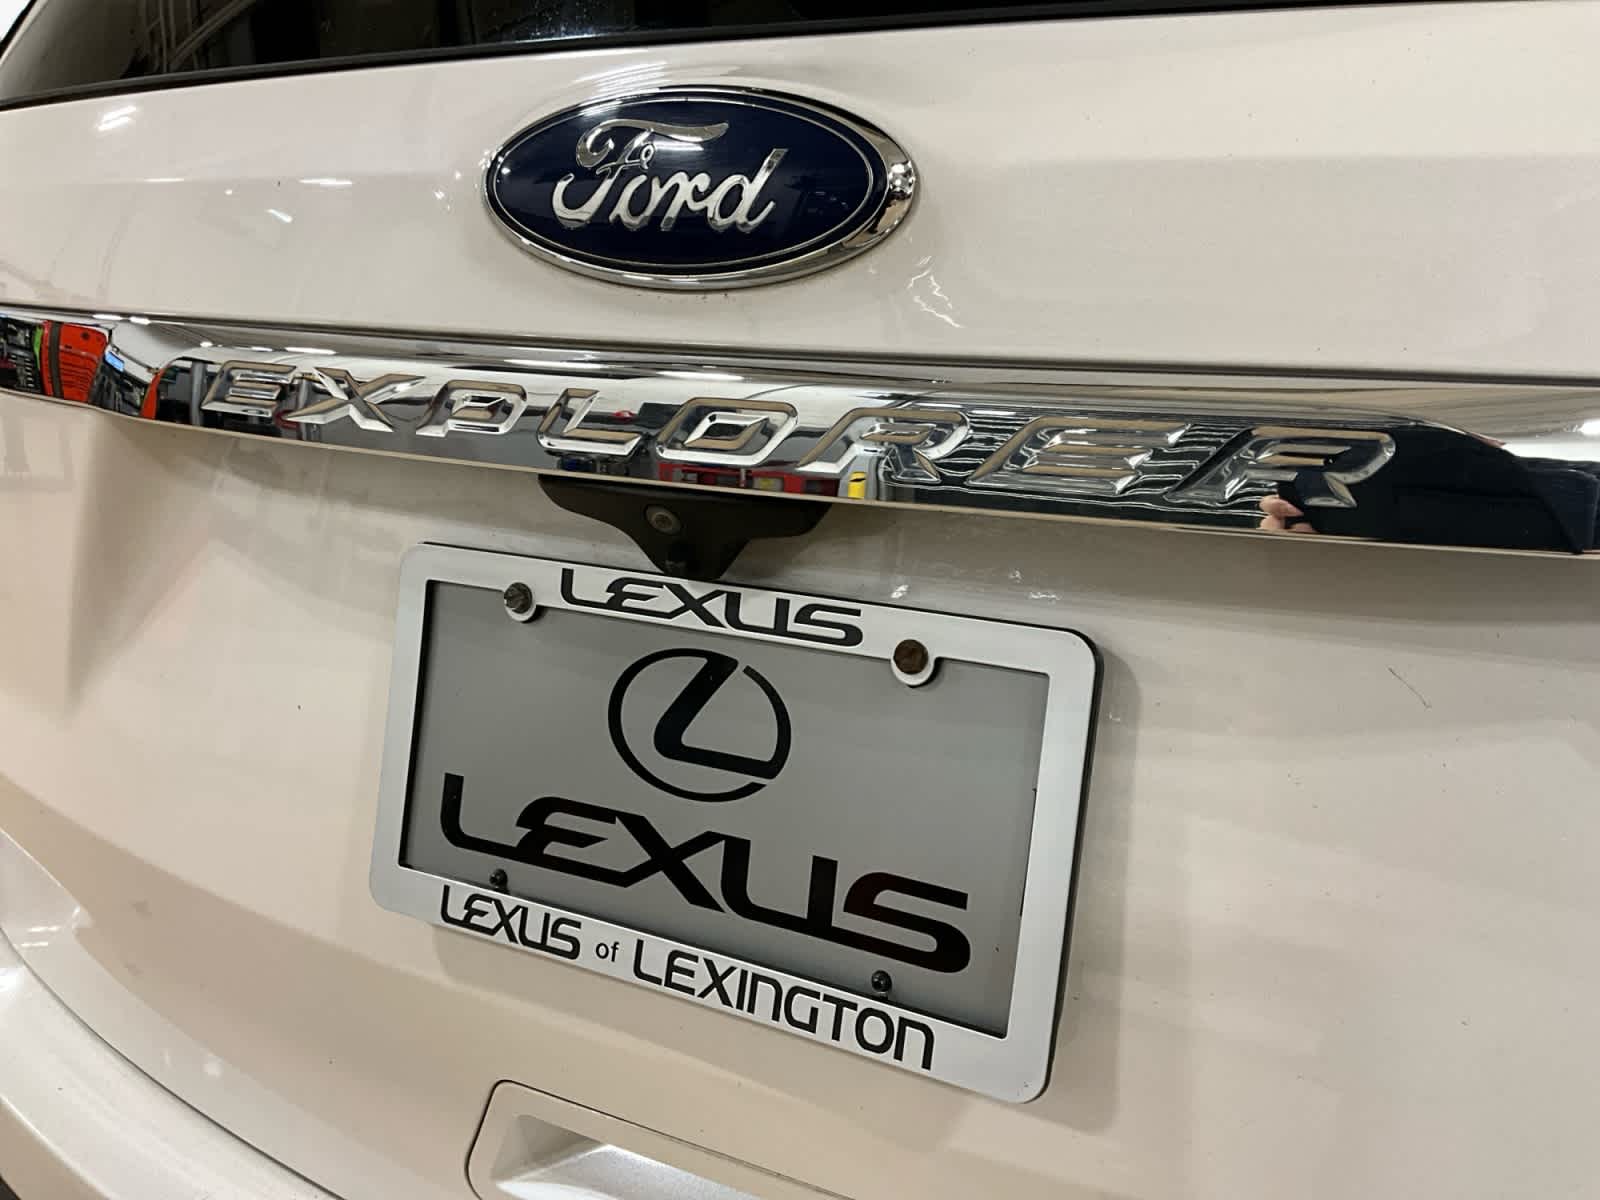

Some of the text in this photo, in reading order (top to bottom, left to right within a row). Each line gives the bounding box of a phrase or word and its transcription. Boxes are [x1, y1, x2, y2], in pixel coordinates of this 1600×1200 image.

[551, 118, 790, 232] Ford
[200, 359, 1397, 510] EXPLORER
[560, 567, 864, 647] LEXUS
[440, 772, 971, 974] LEXUS
[440, 884, 936, 1071] LEXUS of LEXINGTON
